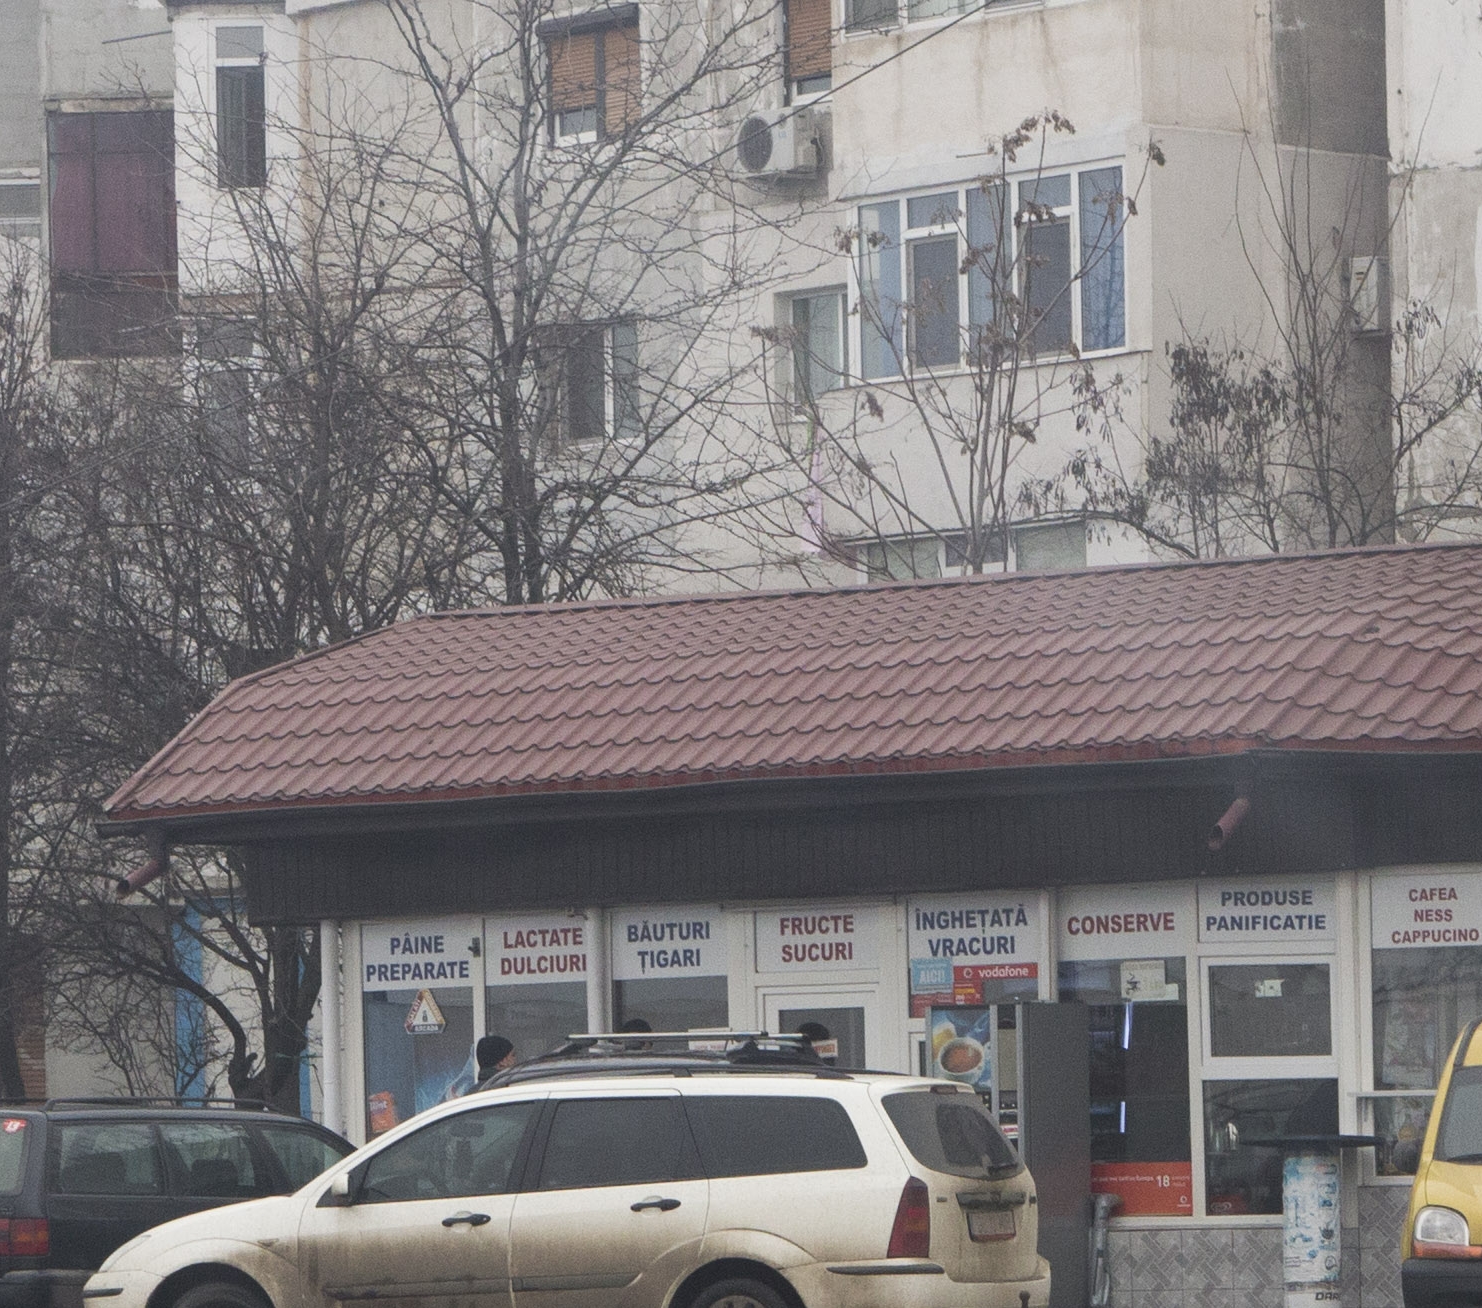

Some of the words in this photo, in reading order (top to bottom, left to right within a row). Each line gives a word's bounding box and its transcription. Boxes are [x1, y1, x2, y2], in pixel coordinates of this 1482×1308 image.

[1221, 890, 1313, 907] PRODUSE
[1408, 887, 1458, 902] CAFEA
[779, 914, 855, 936] FRUCTE
[1067, 911, 1175, 936] CONSERVE
[1205, 914, 1327, 932] PANIFICATIE
[1413, 909, 1454, 923] NESS
[503, 927, 584, 950] LACTATE
[627, 919, 711, 943] BĂUTURI
[1391, 928, 1480, 944] CAPPUCINO
[390, 931, 445, 955] PÂINE
[781, 941, 854, 963] SUCURI
[928, 936, 1016, 957] VRACURI
[365, 960, 470, 983] PREPARATE
[500, 953, 587, 976] DULCIURI
[978, 963, 1030, 980] vodafone
[1155, 1174, 1171, 1188] 18
